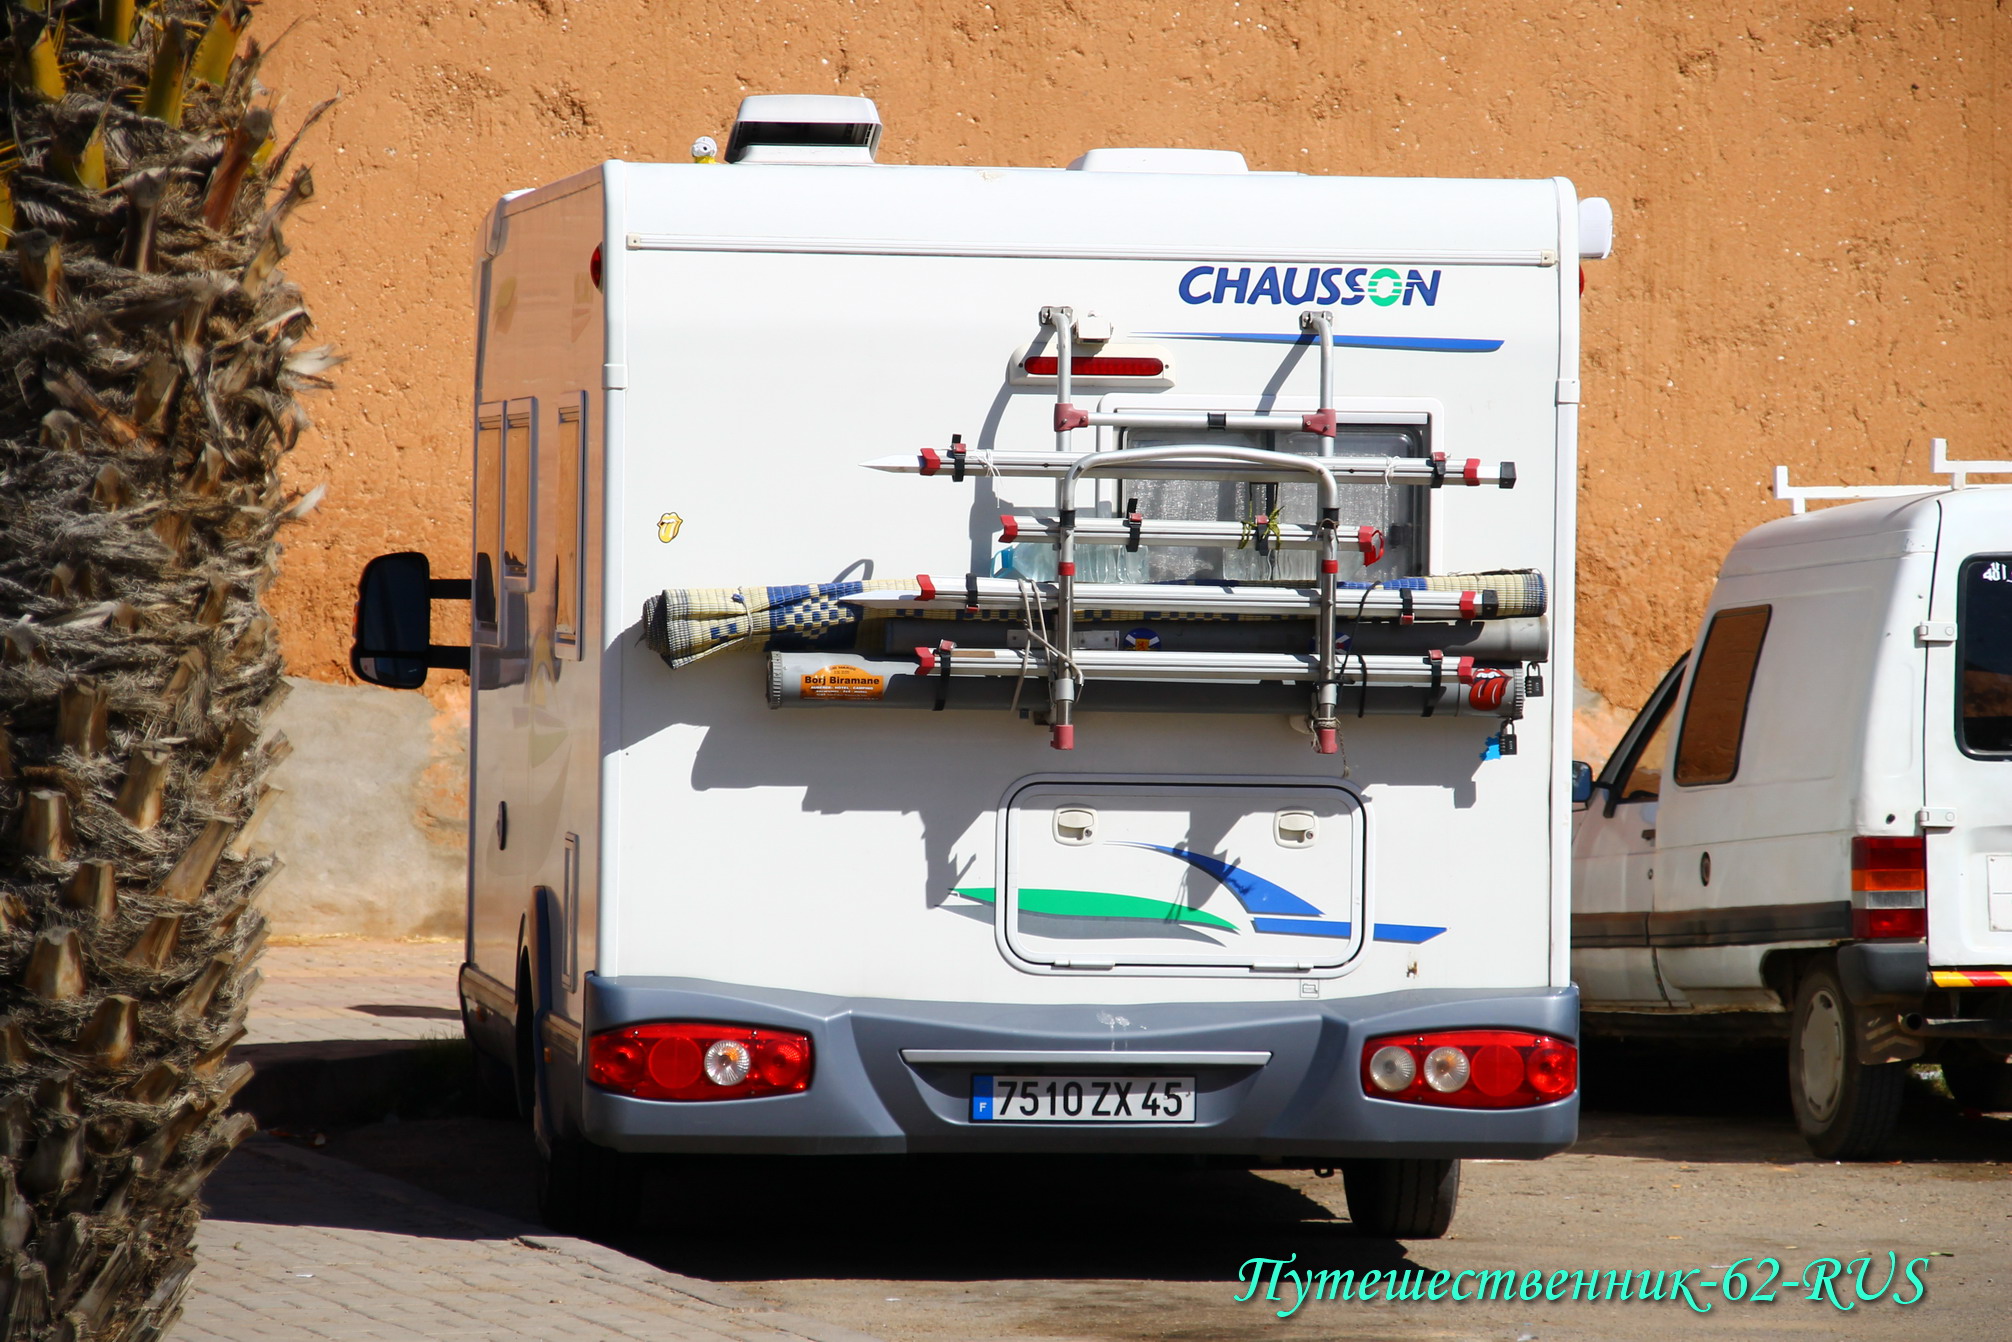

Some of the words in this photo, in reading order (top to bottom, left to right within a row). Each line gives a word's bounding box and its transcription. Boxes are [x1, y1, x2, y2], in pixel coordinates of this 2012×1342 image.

[1178, 265, 1442, 307] CHAUSSON
[804, 676, 826, 685] Borj
[829, 676, 880, 685] Biramane
[979, 1102, 988, 1113] F
[997, 1081, 1083, 1117] 7510
[1091, 1081, 1134, 1117] ZX
[1141, 1081, 1183, 1117] 45
